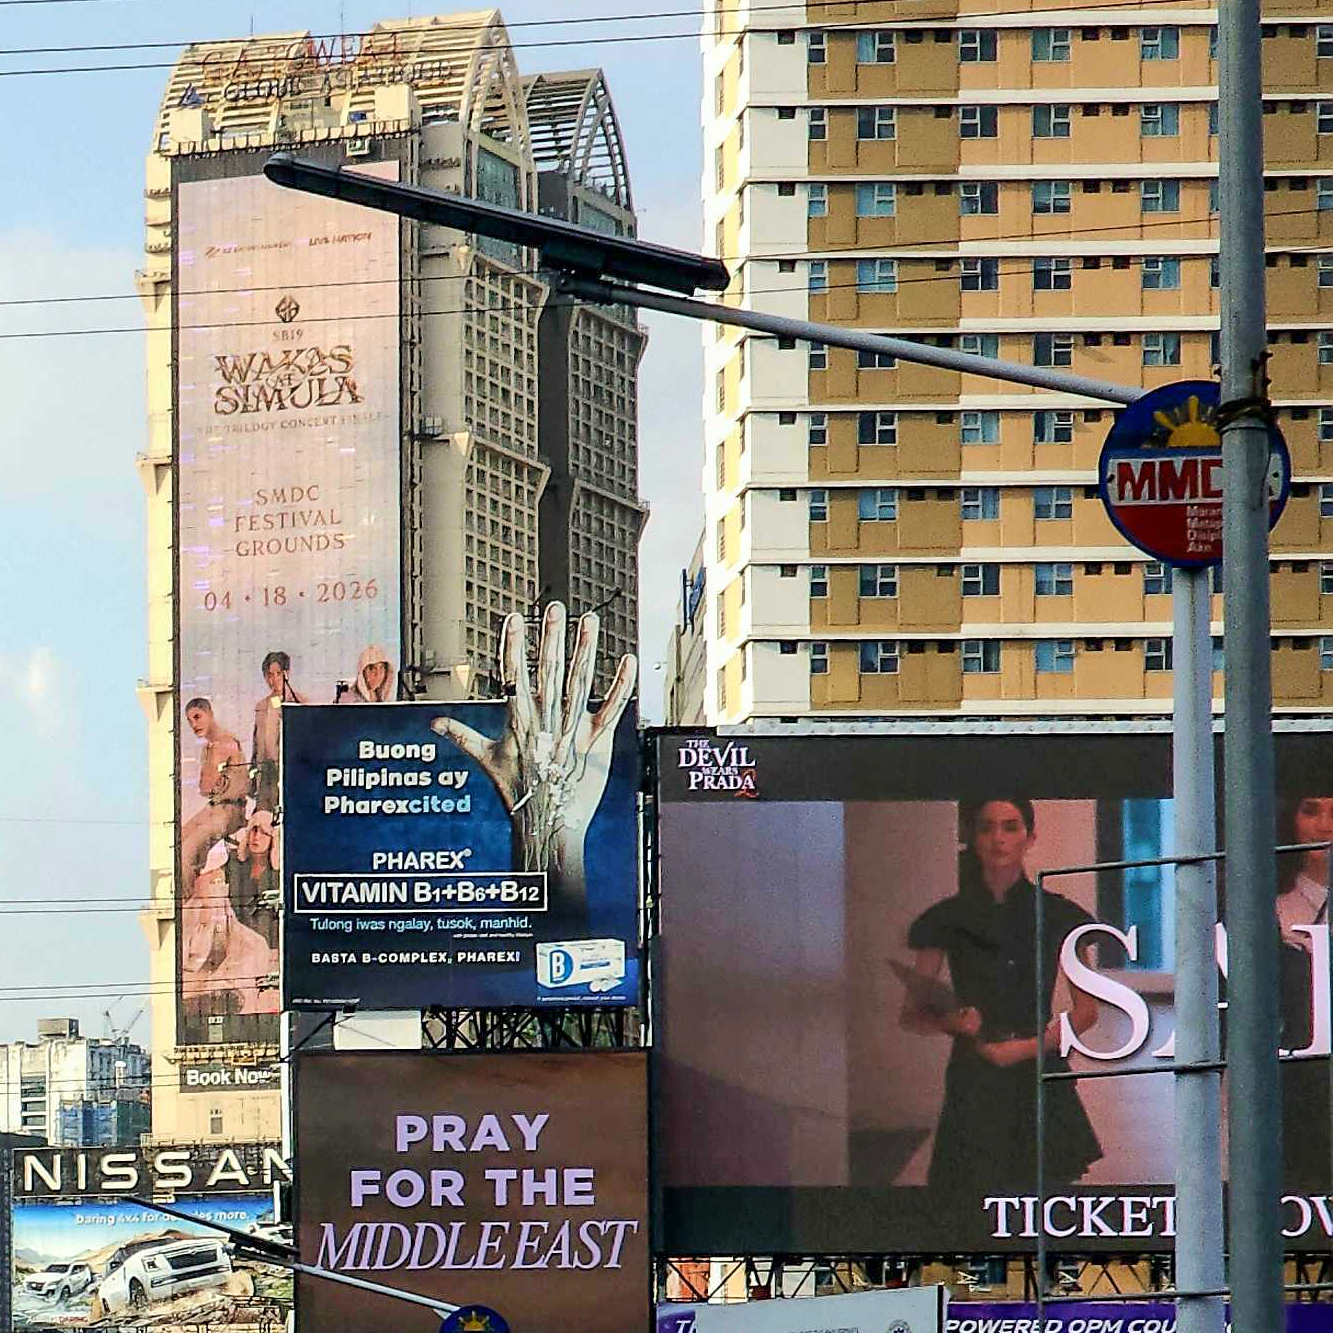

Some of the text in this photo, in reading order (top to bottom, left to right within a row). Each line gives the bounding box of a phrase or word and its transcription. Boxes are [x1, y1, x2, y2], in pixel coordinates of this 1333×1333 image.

[214, 376, 364, 415] SIMULA
[256, 485, 320, 506] SMDC
[235, 508, 342, 533] FESTIVAL
[236, 533, 345, 557] GROUNDS
[204, 578, 378, 611] 04 18 2026
[358, 740, 436, 763] Buong
[678, 741, 756, 767] DEVIL
[685, 739, 710, 749] THE
[326, 768, 469, 790] Pilipinas ay
[688, 771, 755, 790] PRADA
[324, 794, 471, 814] Pharexcited
[302, 880, 540, 904] VITAMIN B1+B6+B12
[310, 914, 533, 933] Tulong iwas ngalay, tusok, manhid.
[312, 952, 357, 964] BASTA
[362, 951, 453, 965] B-COMPLEX,
[187, 1068, 273, 1086] Book Now
[396, 1113, 550, 1152] PRAY
[23, 1149, 294, 1192] NISSAN
[350, 1168, 595, 1207] FOR THE
[76, 1212, 115, 1226] Daring
[142, 1211, 159, 1222] for
[215, 1210, 249, 1220] more.
[317, 1220, 638, 1270] MIDDLE EAST
